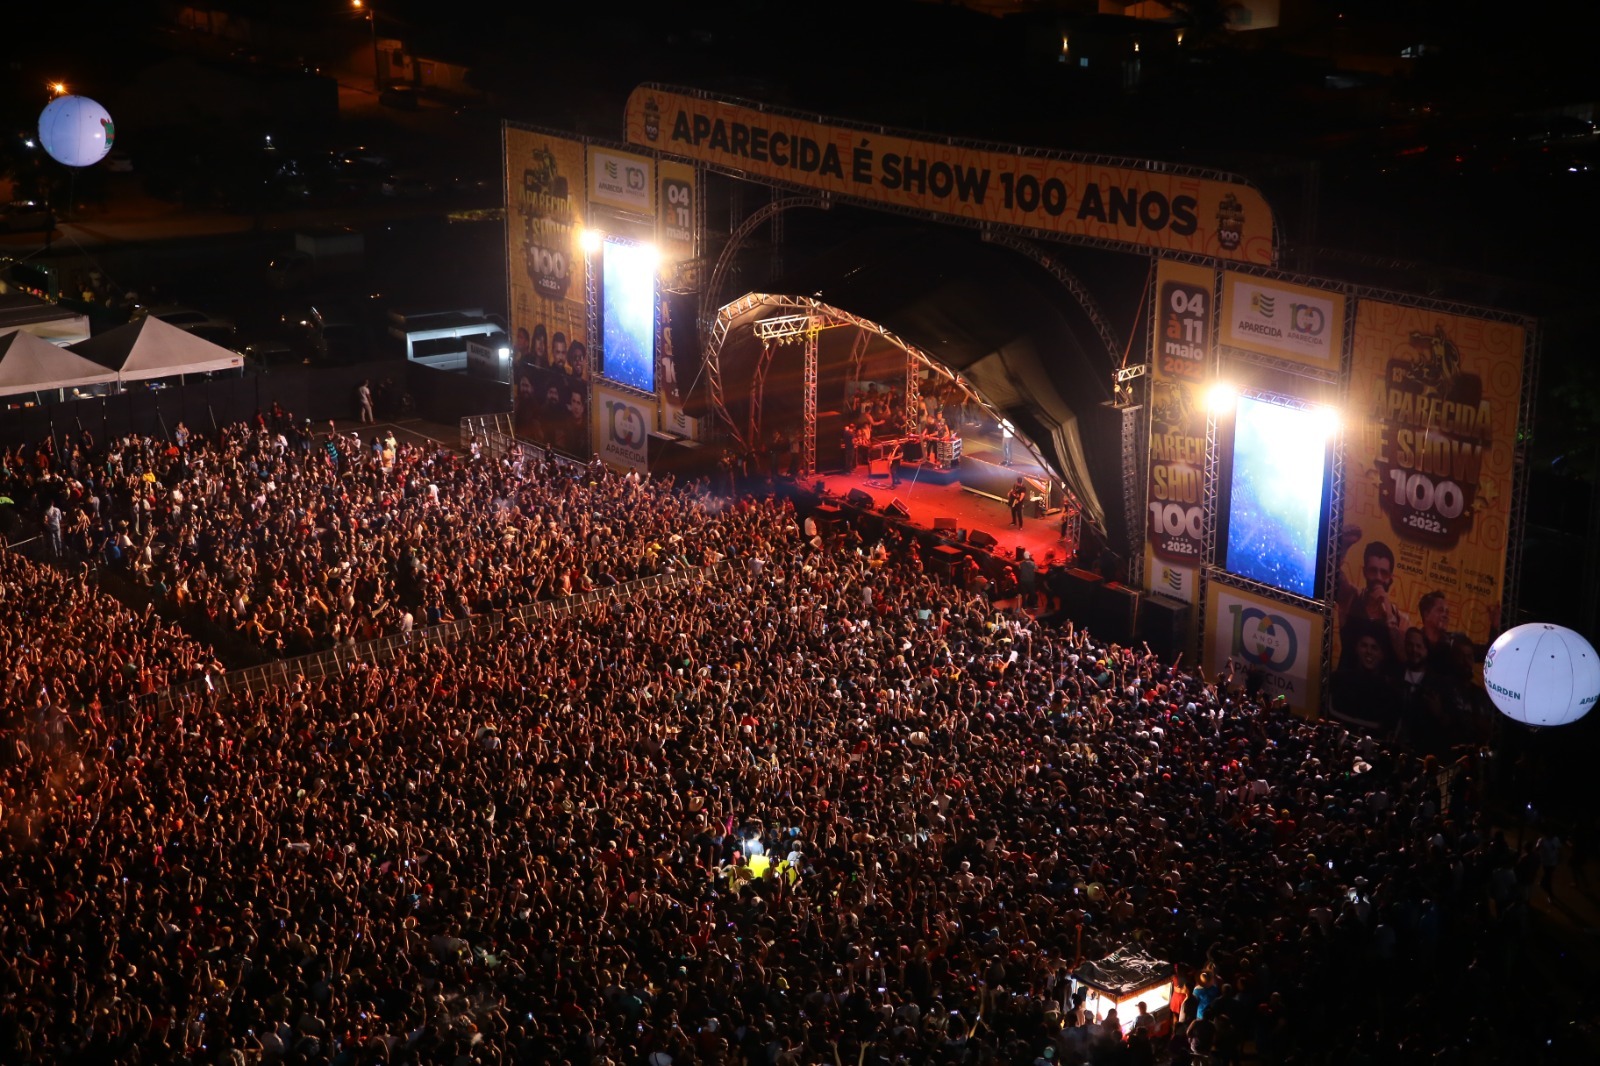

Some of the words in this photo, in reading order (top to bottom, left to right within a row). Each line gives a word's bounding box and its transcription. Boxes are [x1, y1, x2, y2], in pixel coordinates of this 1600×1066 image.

[672, 111, 843, 179] APARECIDA
[853, 138, 873, 185] É
[882, 153, 990, 204] SHOW
[1000, 172, 1067, 216] 100
[1077, 183, 1198, 236] ANOS
[668, 185, 690, 206] 04
[676, 207, 690, 228] 11
[666, 227, 691, 241] maio
[1220, 230, 1239, 242] 100
[530, 247, 565, 279] 100
[1171, 289, 1205, 317] 04
[1167, 313, 1182, 340] à
[1183, 319, 1204, 344] 11
[1238, 321, 1283, 338] APARECIDA
[1165, 341, 1205, 361] maio
[1373, 378, 1492, 444] APARECIDA
[606, 443, 646, 465] APARECIDA
[1397, 428, 1482, 485] SHOW
[1390, 468, 1464, 519] 100
[1149, 501, 1203, 540] 100
[1409, 515, 1441, 533] 2022
[1167, 541, 1193, 554] 2022
